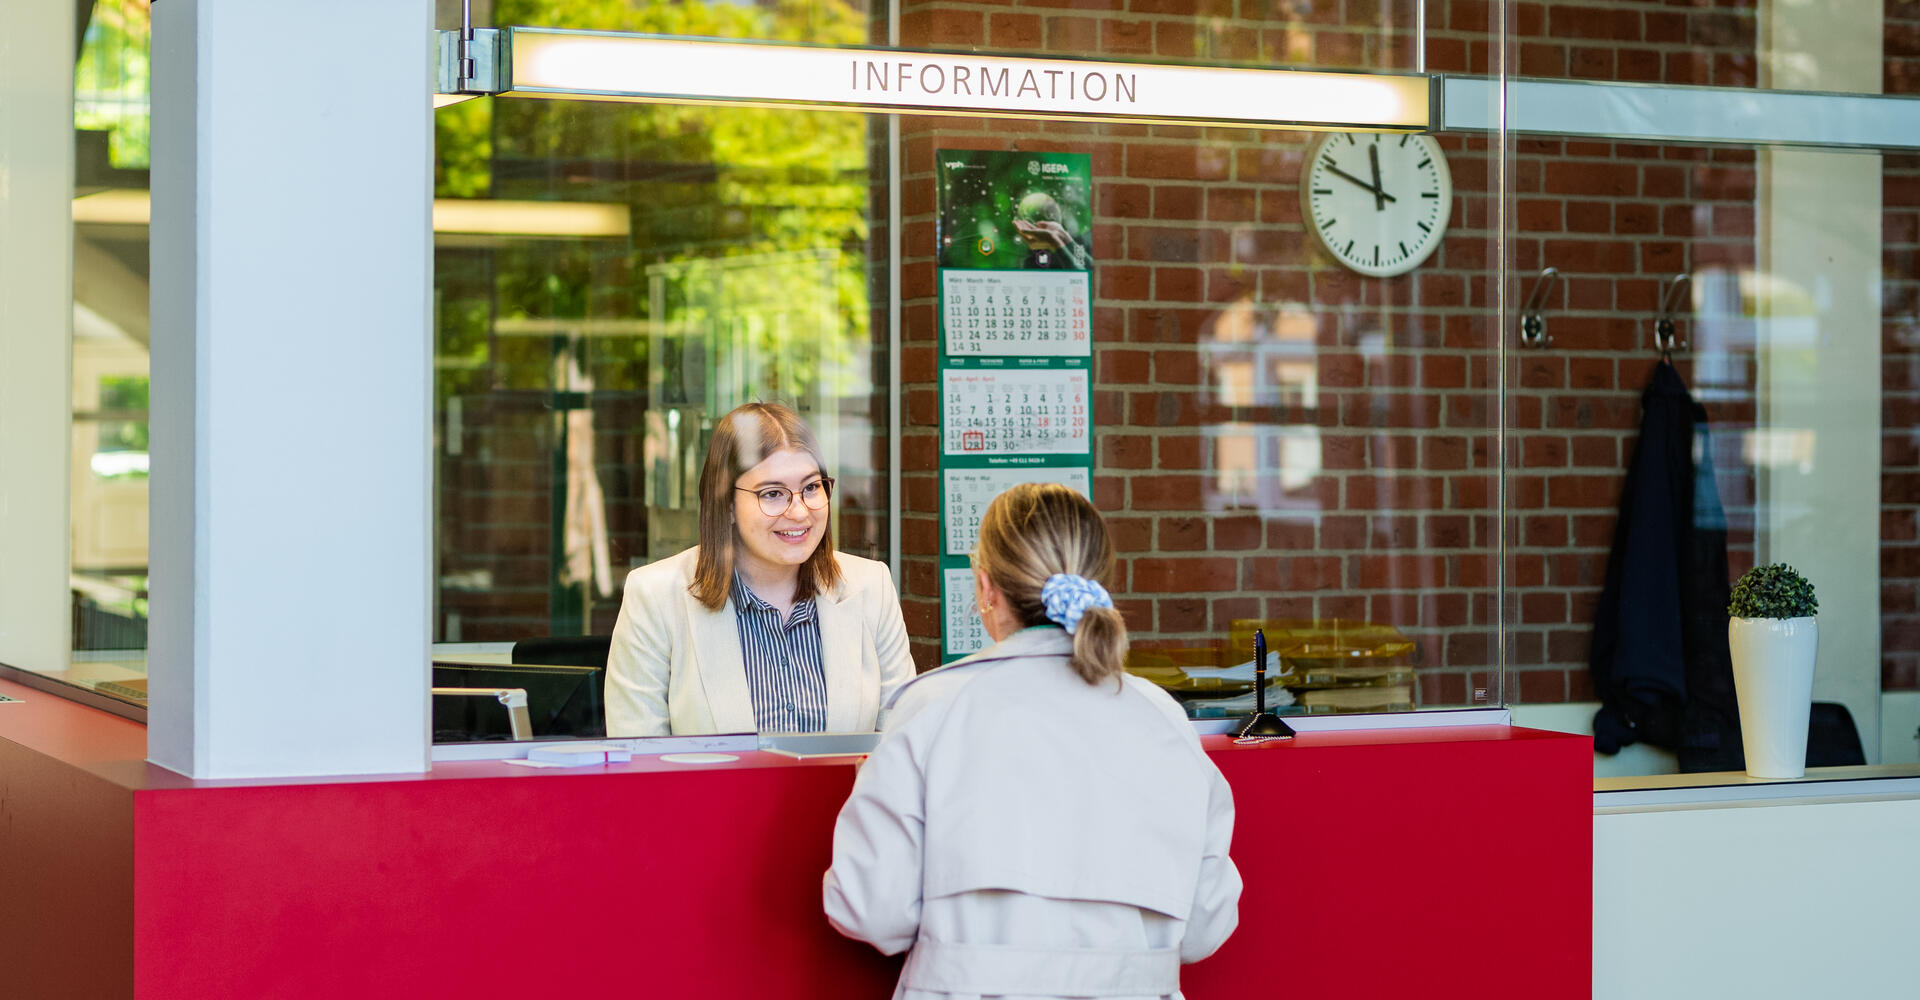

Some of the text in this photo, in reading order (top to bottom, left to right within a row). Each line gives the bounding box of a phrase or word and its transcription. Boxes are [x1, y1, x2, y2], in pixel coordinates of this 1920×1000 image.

[852, 60, 1136, 103] INFORMATION
[1042, 164, 1069, 174] IGEPA
[950, 295, 961, 304] 10
[971, 296, 975, 305] 3
[987, 296, 993, 304] 4
[1005, 296, 1011, 305] 5
[1022, 296, 1028, 305] 6
[1040, 296, 1045, 304] 7
[951, 307, 1084, 317] 11 10 11 12 13 14 15 16
[952, 319, 1084, 329] 12 17 18 19 20 21 22 23
[952, 330, 1085, 340] 13 24 25 26 27 28 29 30
[953, 342, 981, 351] 14 31
[950, 393, 1080, 403] 14 1 2 3 4 5 6
[950, 405, 1083, 415] 15 7 8 9 10 11 12 13
[950, 417, 1084, 427] 16 14 15 16 17 18 19 20
[950, 430, 961, 438] 17
[985, 430, 996, 438] 22
[1003, 428, 1014, 438] 23
[1020, 429, 1032, 438] 24
[1038, 429, 1049, 440] 25
[1054, 429, 1067, 438] 26
[1072, 429, 1083, 438] 27
[950, 441, 1015, 450] 18 28 29 30
[951, 493, 962, 503] 18
[952, 505, 976, 514] 19 5
[952, 517, 979, 526] 20 12
[953, 529, 963, 538] 21
[953, 541, 964, 550] 22
[951, 593, 962, 602] 23
[952, 605, 963, 614] 24
[952, 617, 981, 627] 25 16
[953, 628, 981, 638] 26 23
[952, 640, 982, 650] 27 30
